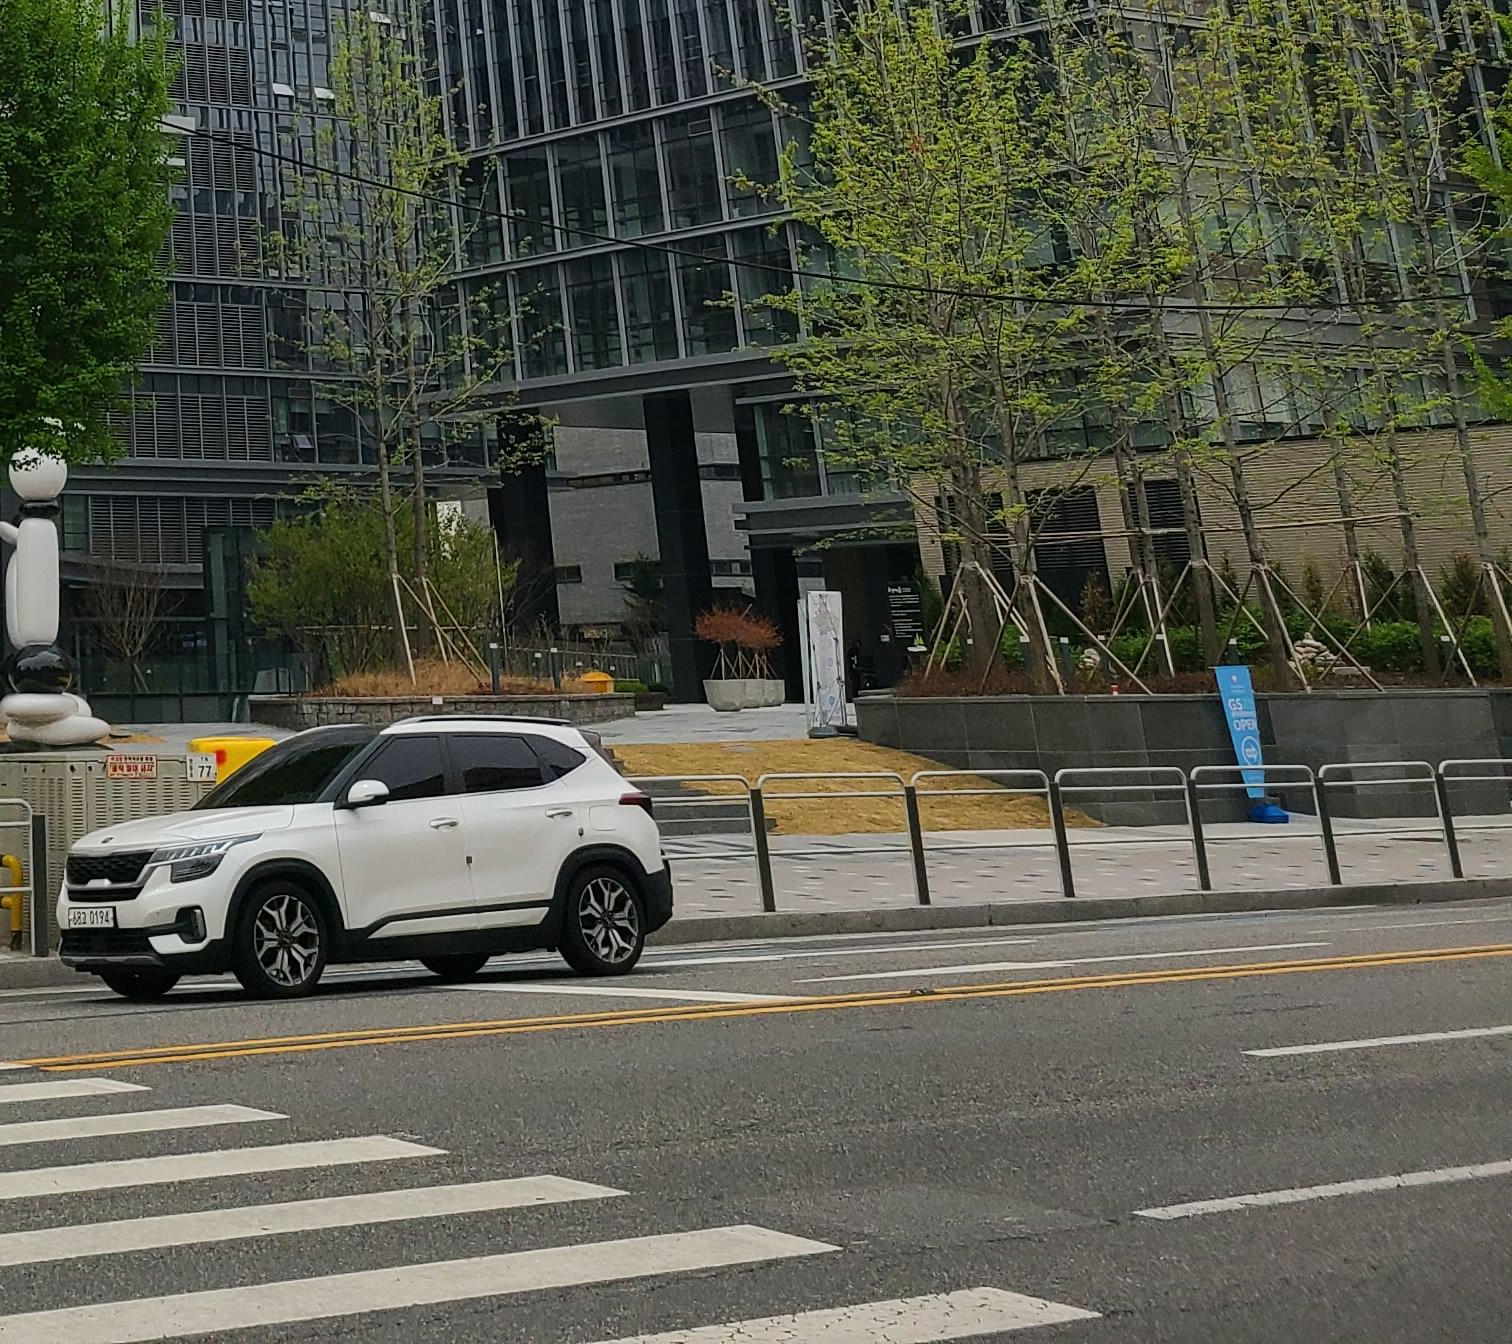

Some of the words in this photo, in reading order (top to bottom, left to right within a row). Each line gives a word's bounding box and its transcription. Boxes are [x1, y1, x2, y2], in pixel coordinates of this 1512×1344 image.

[1228, 698, 1243, 711] GS
[198, 765, 212, 778] 77
[89, 910, 110, 925] 0194
